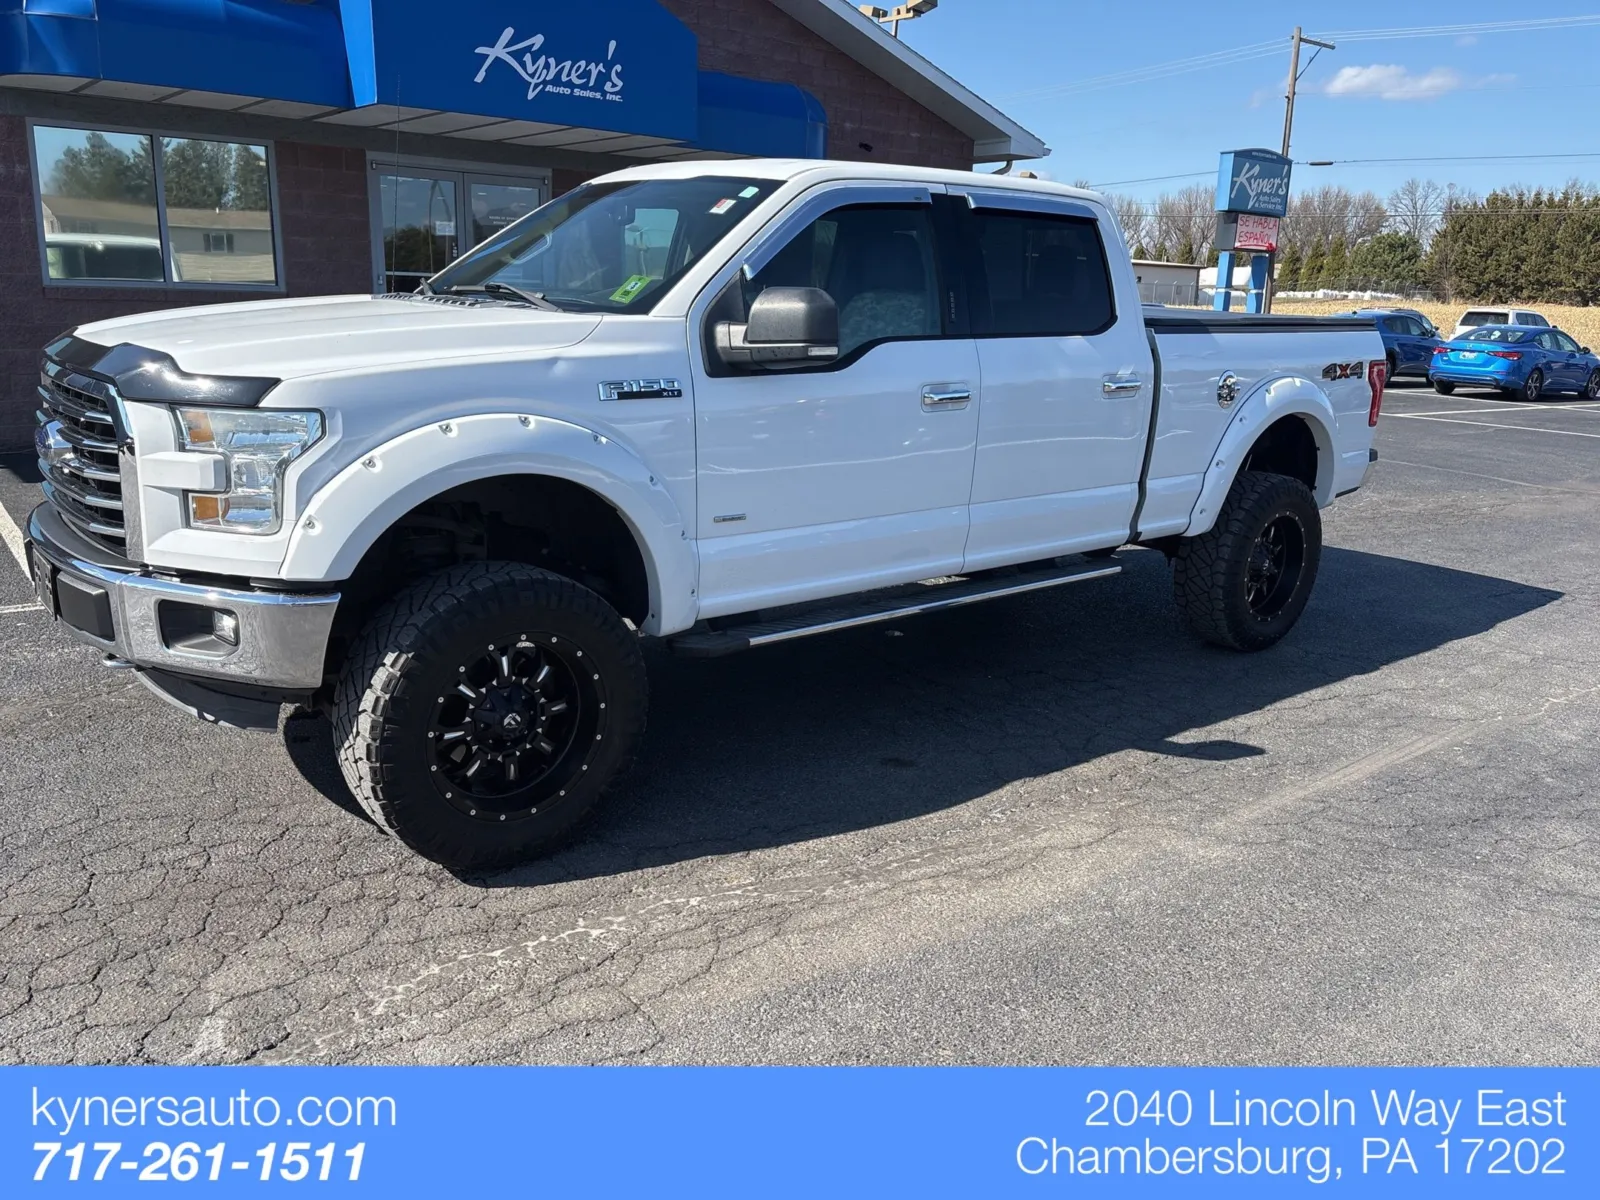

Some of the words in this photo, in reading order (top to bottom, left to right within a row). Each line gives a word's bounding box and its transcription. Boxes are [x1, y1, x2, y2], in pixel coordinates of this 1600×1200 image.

[474, 26, 624, 101] Kyner's
[545, 84, 571, 95] Auto
[573, 88, 604, 101] Sales,
[606, 92, 624, 102] Inc.
[1231, 162, 1289, 210] Kyner's
[1257, 194, 1270, 202] Auto
[1239, 215, 1250, 227] SE
[1252, 217, 1277, 230] HABLA
